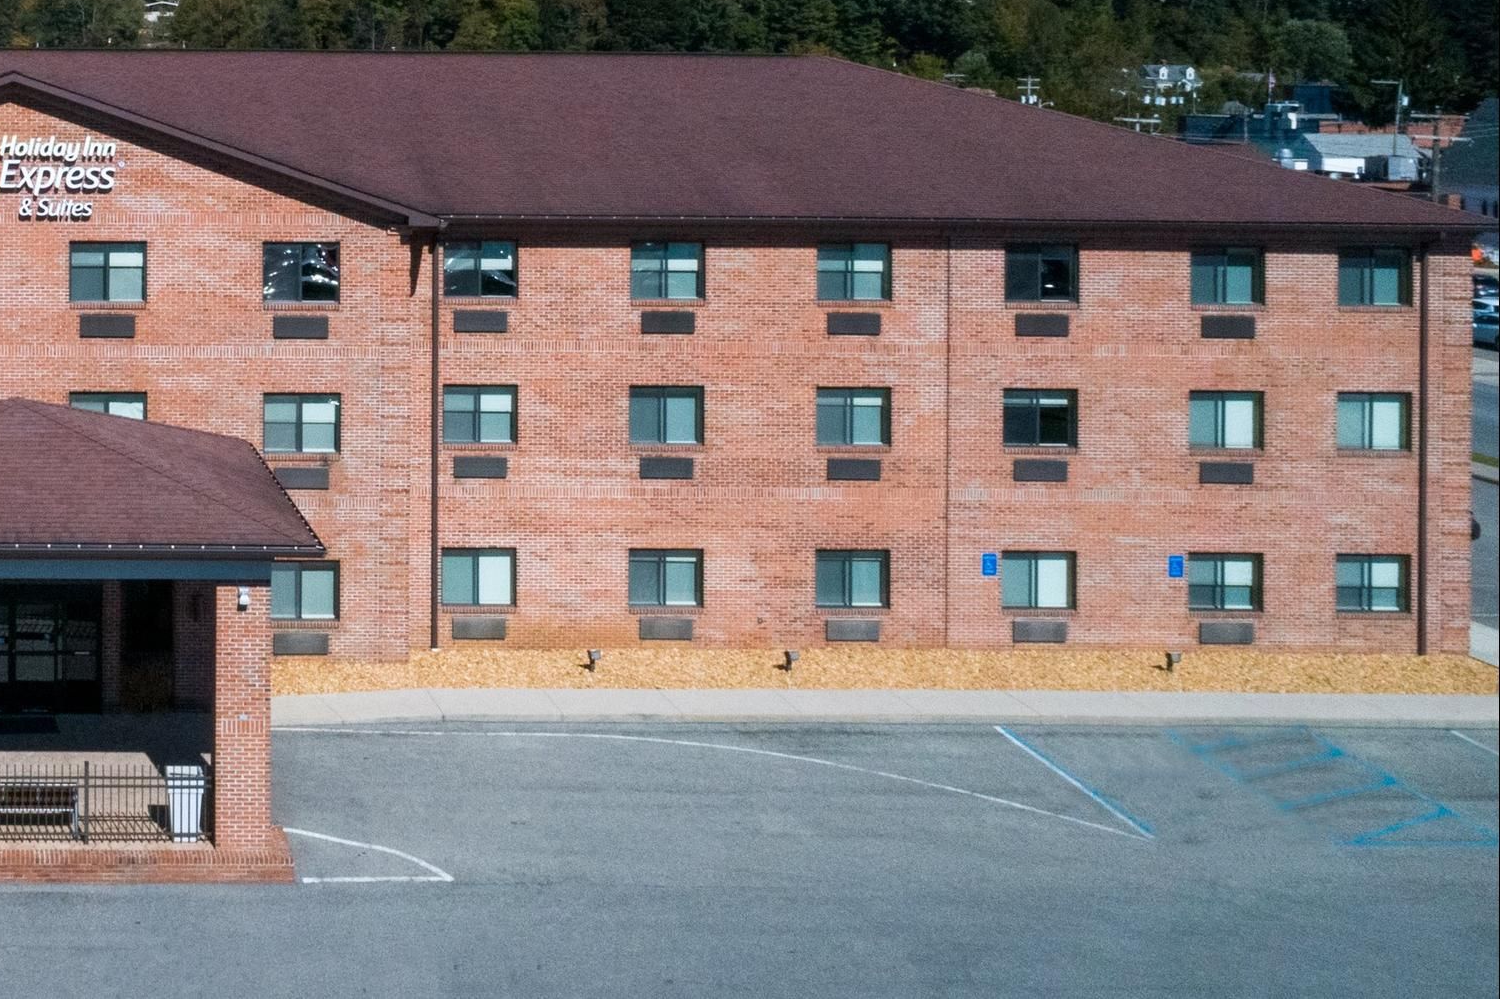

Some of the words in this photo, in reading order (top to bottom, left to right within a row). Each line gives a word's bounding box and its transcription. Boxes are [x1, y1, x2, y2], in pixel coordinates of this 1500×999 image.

[0, 135, 80, 161] Holiday
[83, 135, 117, 157] Inn
[0, 159, 116, 196] Express
[20, 198, 33, 216] &
[36, 198, 93, 216] Suites
